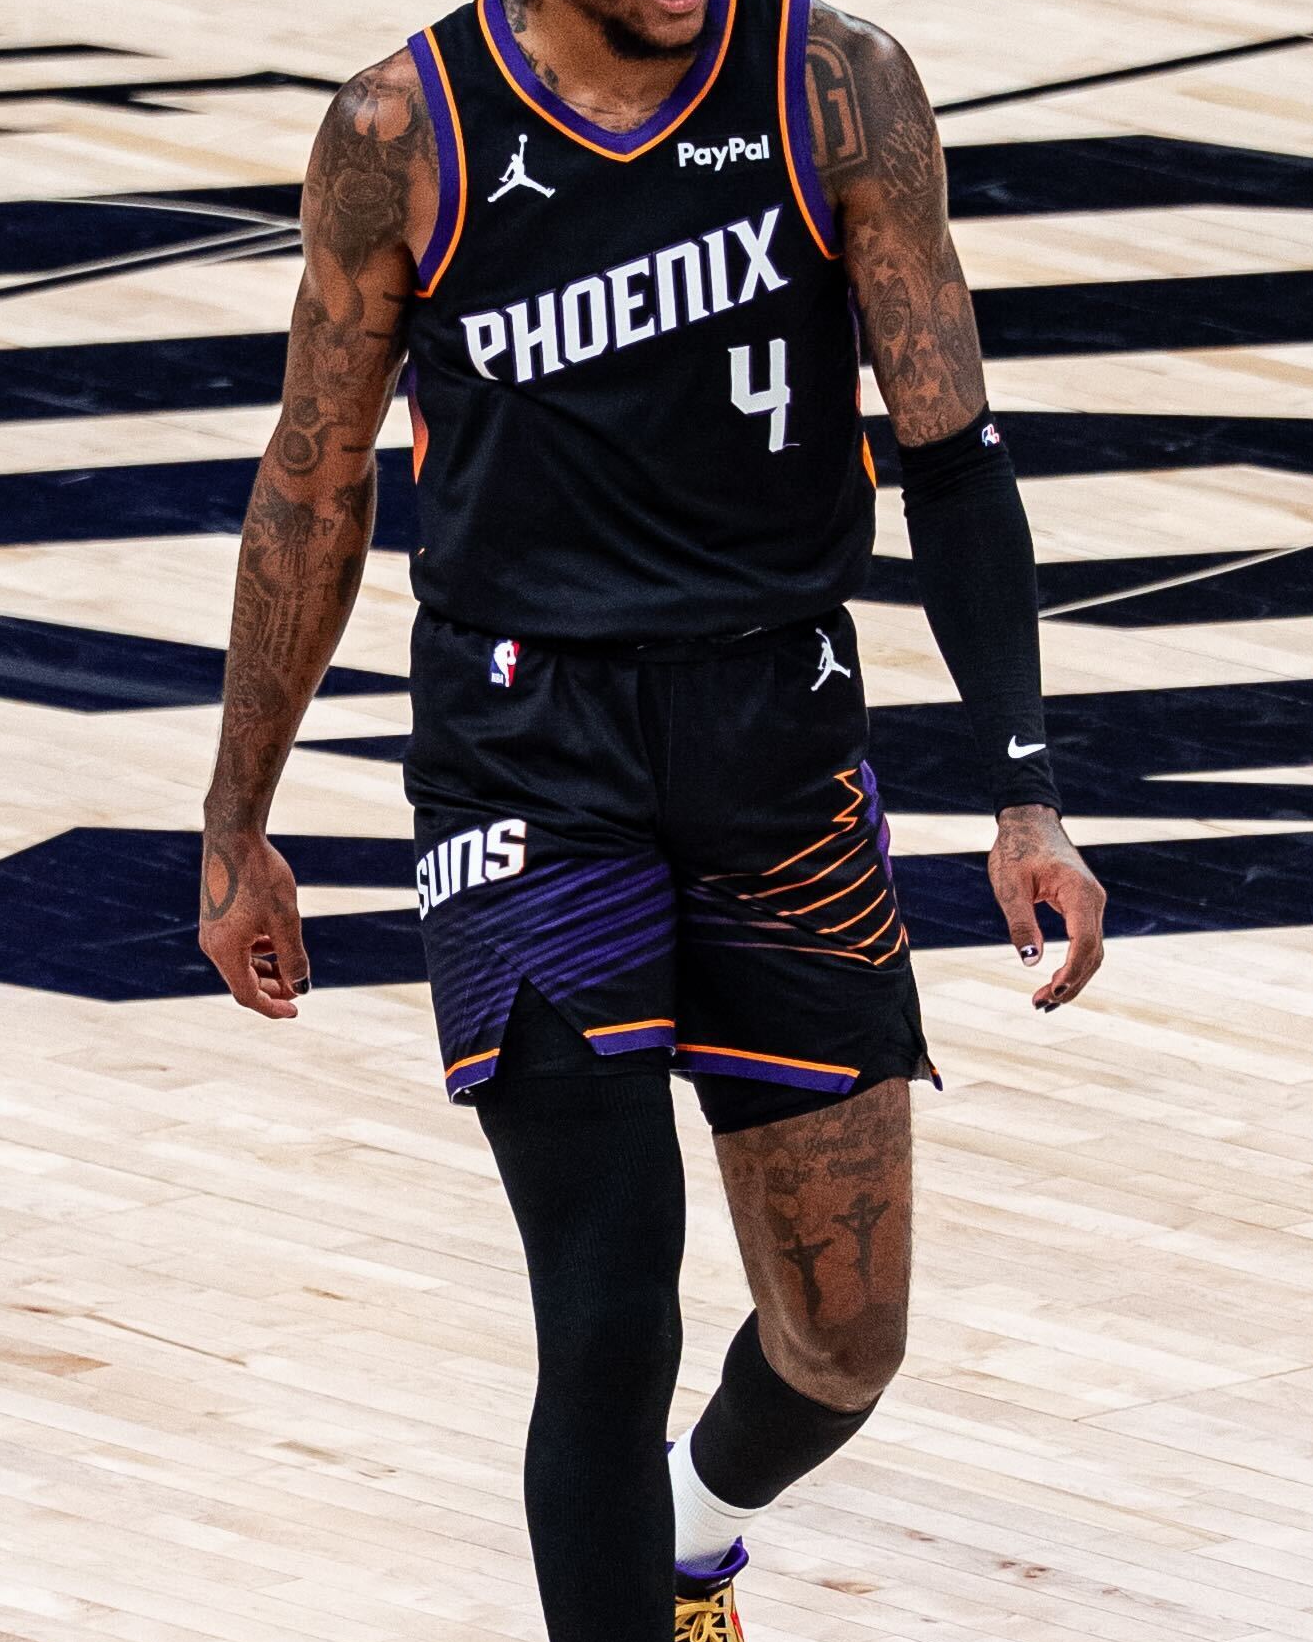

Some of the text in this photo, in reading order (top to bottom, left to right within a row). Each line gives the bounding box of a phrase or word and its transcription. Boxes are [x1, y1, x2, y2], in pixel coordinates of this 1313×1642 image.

[677, 134, 771, 172] PayPal
[459, 206, 791, 384] PHOENIX
[727, 338, 791, 453] 4
